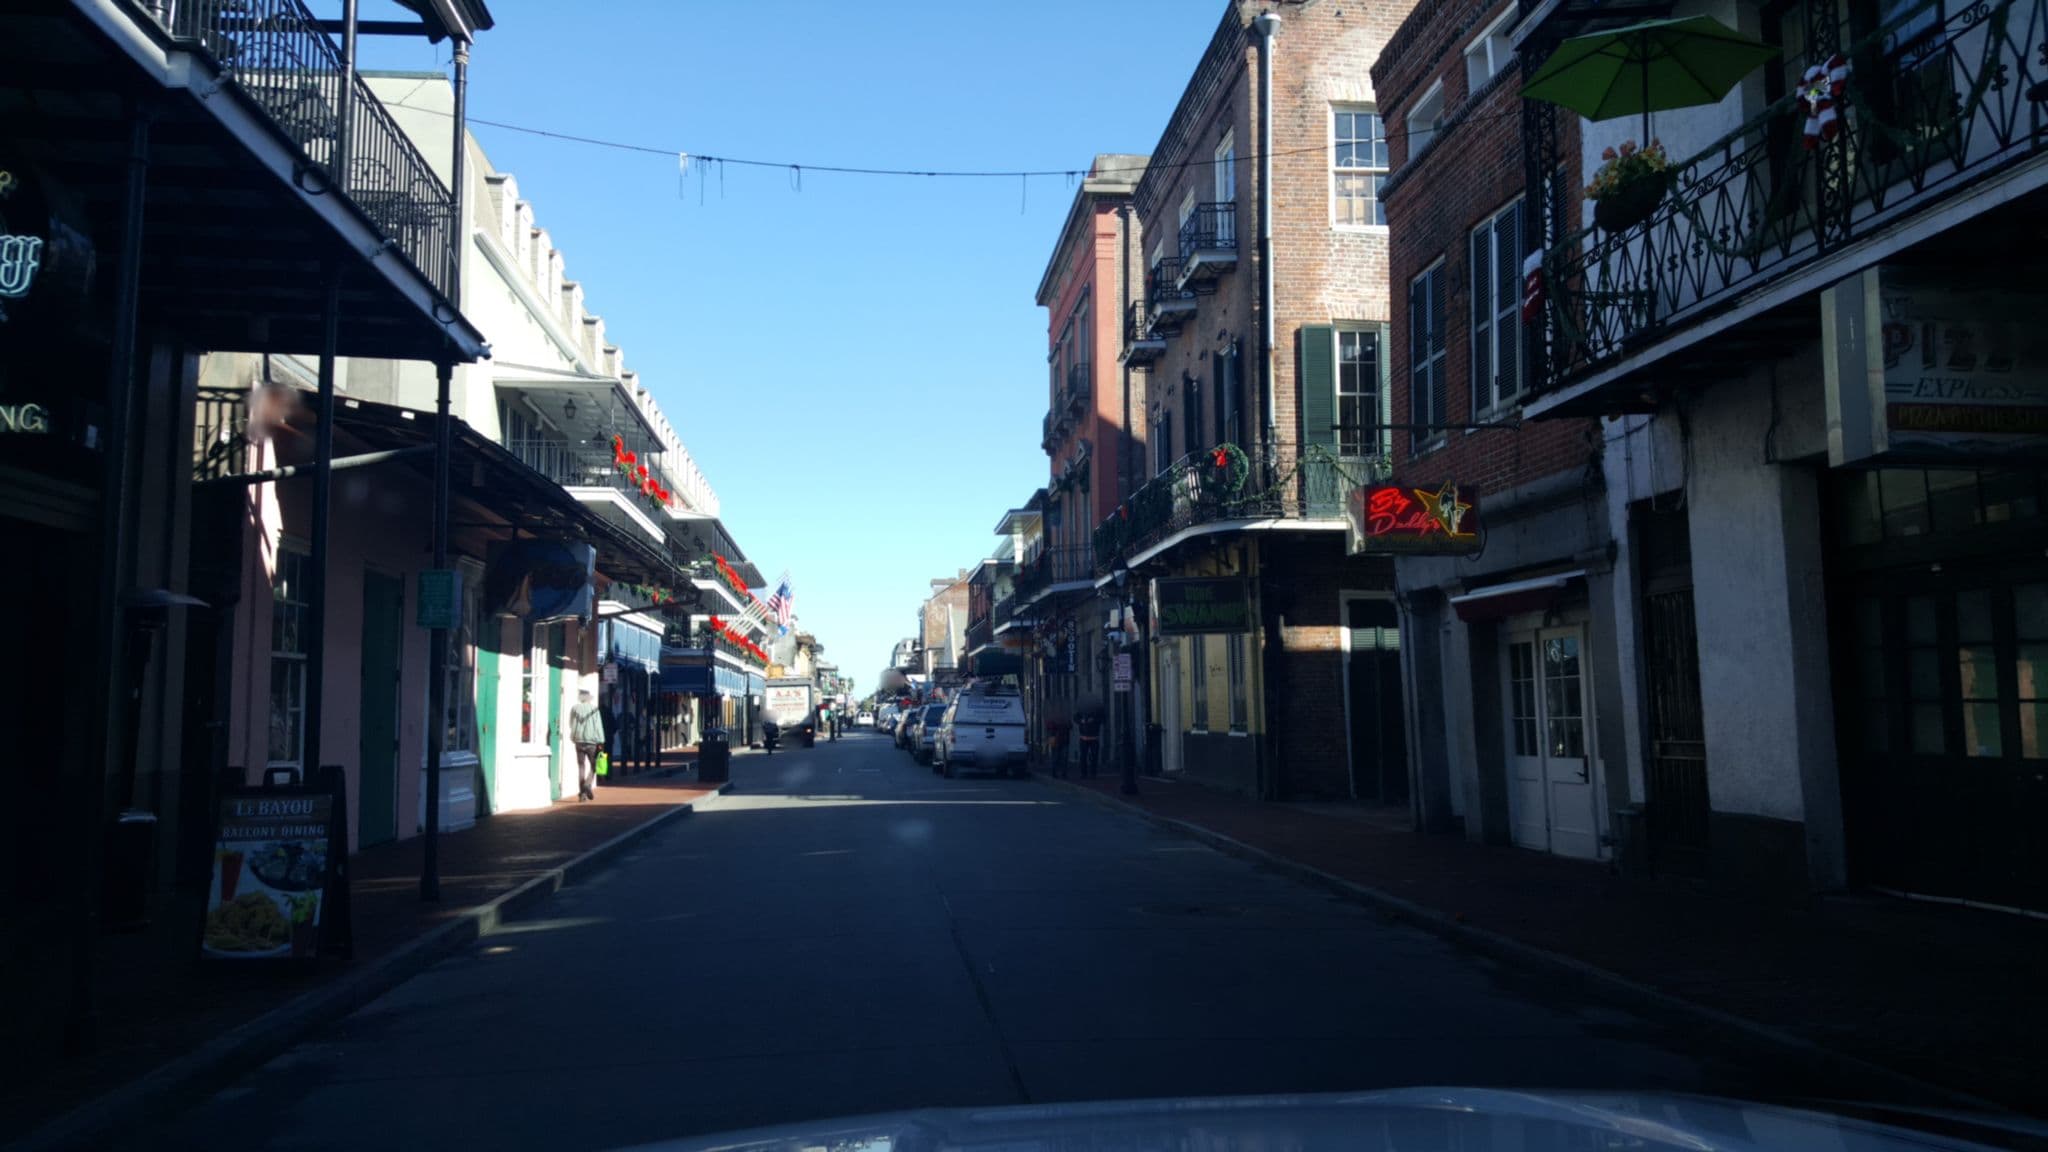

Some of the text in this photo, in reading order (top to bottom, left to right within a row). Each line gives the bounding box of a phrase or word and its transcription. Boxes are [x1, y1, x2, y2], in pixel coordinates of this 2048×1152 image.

[1913, 377, 2025, 400] EXPRESS
[1898, 406, 1946, 426] PIZZA
[1369, 486, 1412, 515] Big
[258, 799, 314, 816] BAYOU
[222, 824, 325, 838] BALCONY DINING
